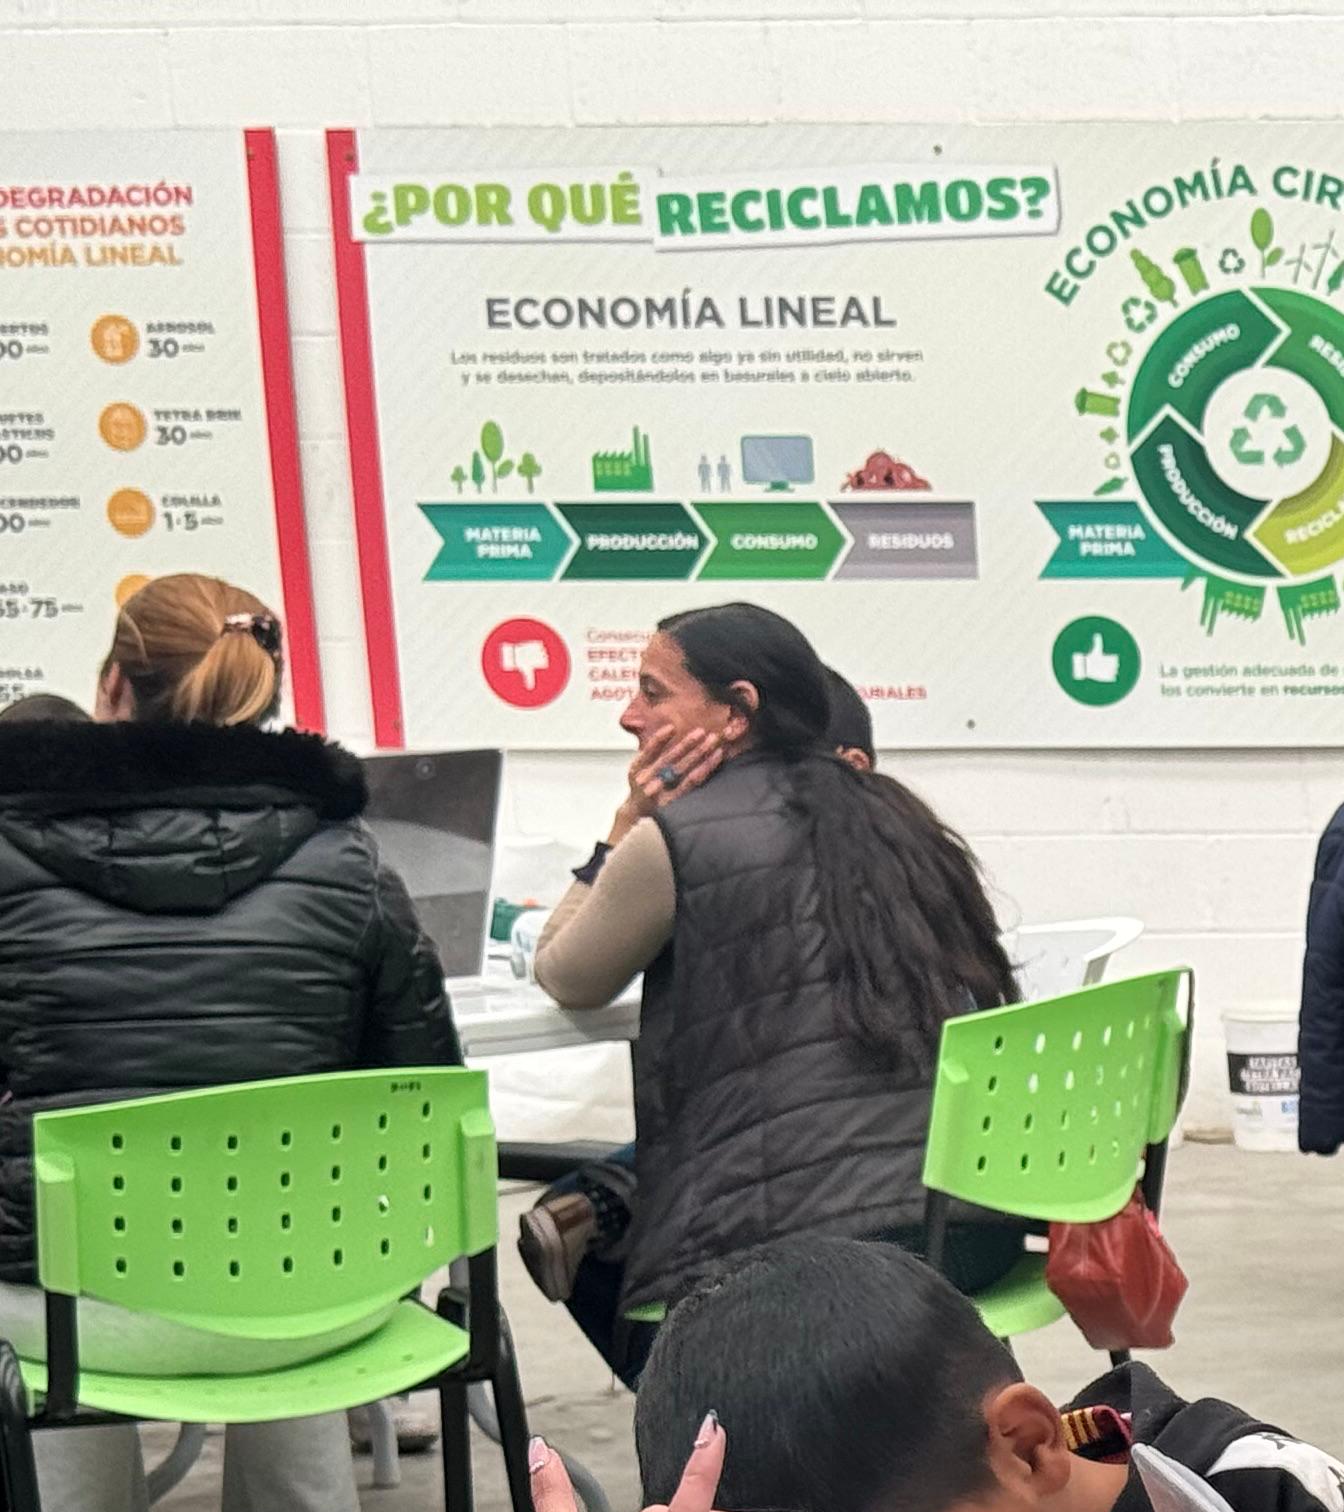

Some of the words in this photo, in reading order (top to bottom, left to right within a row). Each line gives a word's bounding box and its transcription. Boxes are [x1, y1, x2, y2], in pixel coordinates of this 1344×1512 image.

[362, 182, 513, 235] ¿POR
[528, 171, 643, 231] QUÉ
[656, 176, 1051, 235] RECICLAMOS?
[15, 215, 186, 238] COTIDIANOS
[1044, 157, 1258, 306] ECONOMÍA
[84, 243, 184, 266] LINEAL
[486, 286, 725, 329] ECONOMÍA
[739, 295, 898, 328] LINEAL
[451, 349, 478, 365] Los
[482, 349, 546, 364] residuos
[551, 352, 578, 364] son
[582, 349, 647, 364] tratados
[651, 351, 694, 363] como
[1168, 322, 1241, 389] CONSUMO
[1158, 442, 1239, 541] PRODUCCIÓN
[464, 526, 542, 542] MATERIA
[587, 530, 699, 551] PRODUCCIÓN
[732, 532, 819, 550] CONSUMO
[868, 532, 954, 549] RESIDUOS
[1068, 524, 1146, 541] MATERIA
[477, 542, 533, 560] PRIMA
[1079, 541, 1137, 557] PRIMA
[588, 649, 642, 662] EFECT
[1160, 662, 1178, 678] La
[1183, 663, 1237, 680] gestión
[1242, 663, 1316, 677] adecuada
[1320, 664, 1339, 677] de
[591, 686, 636, 701] AGOT
[1160, 683, 1181, 697] los
[1186, 683, 1256, 697] convierte
[1260, 685, 1279, 697] en
